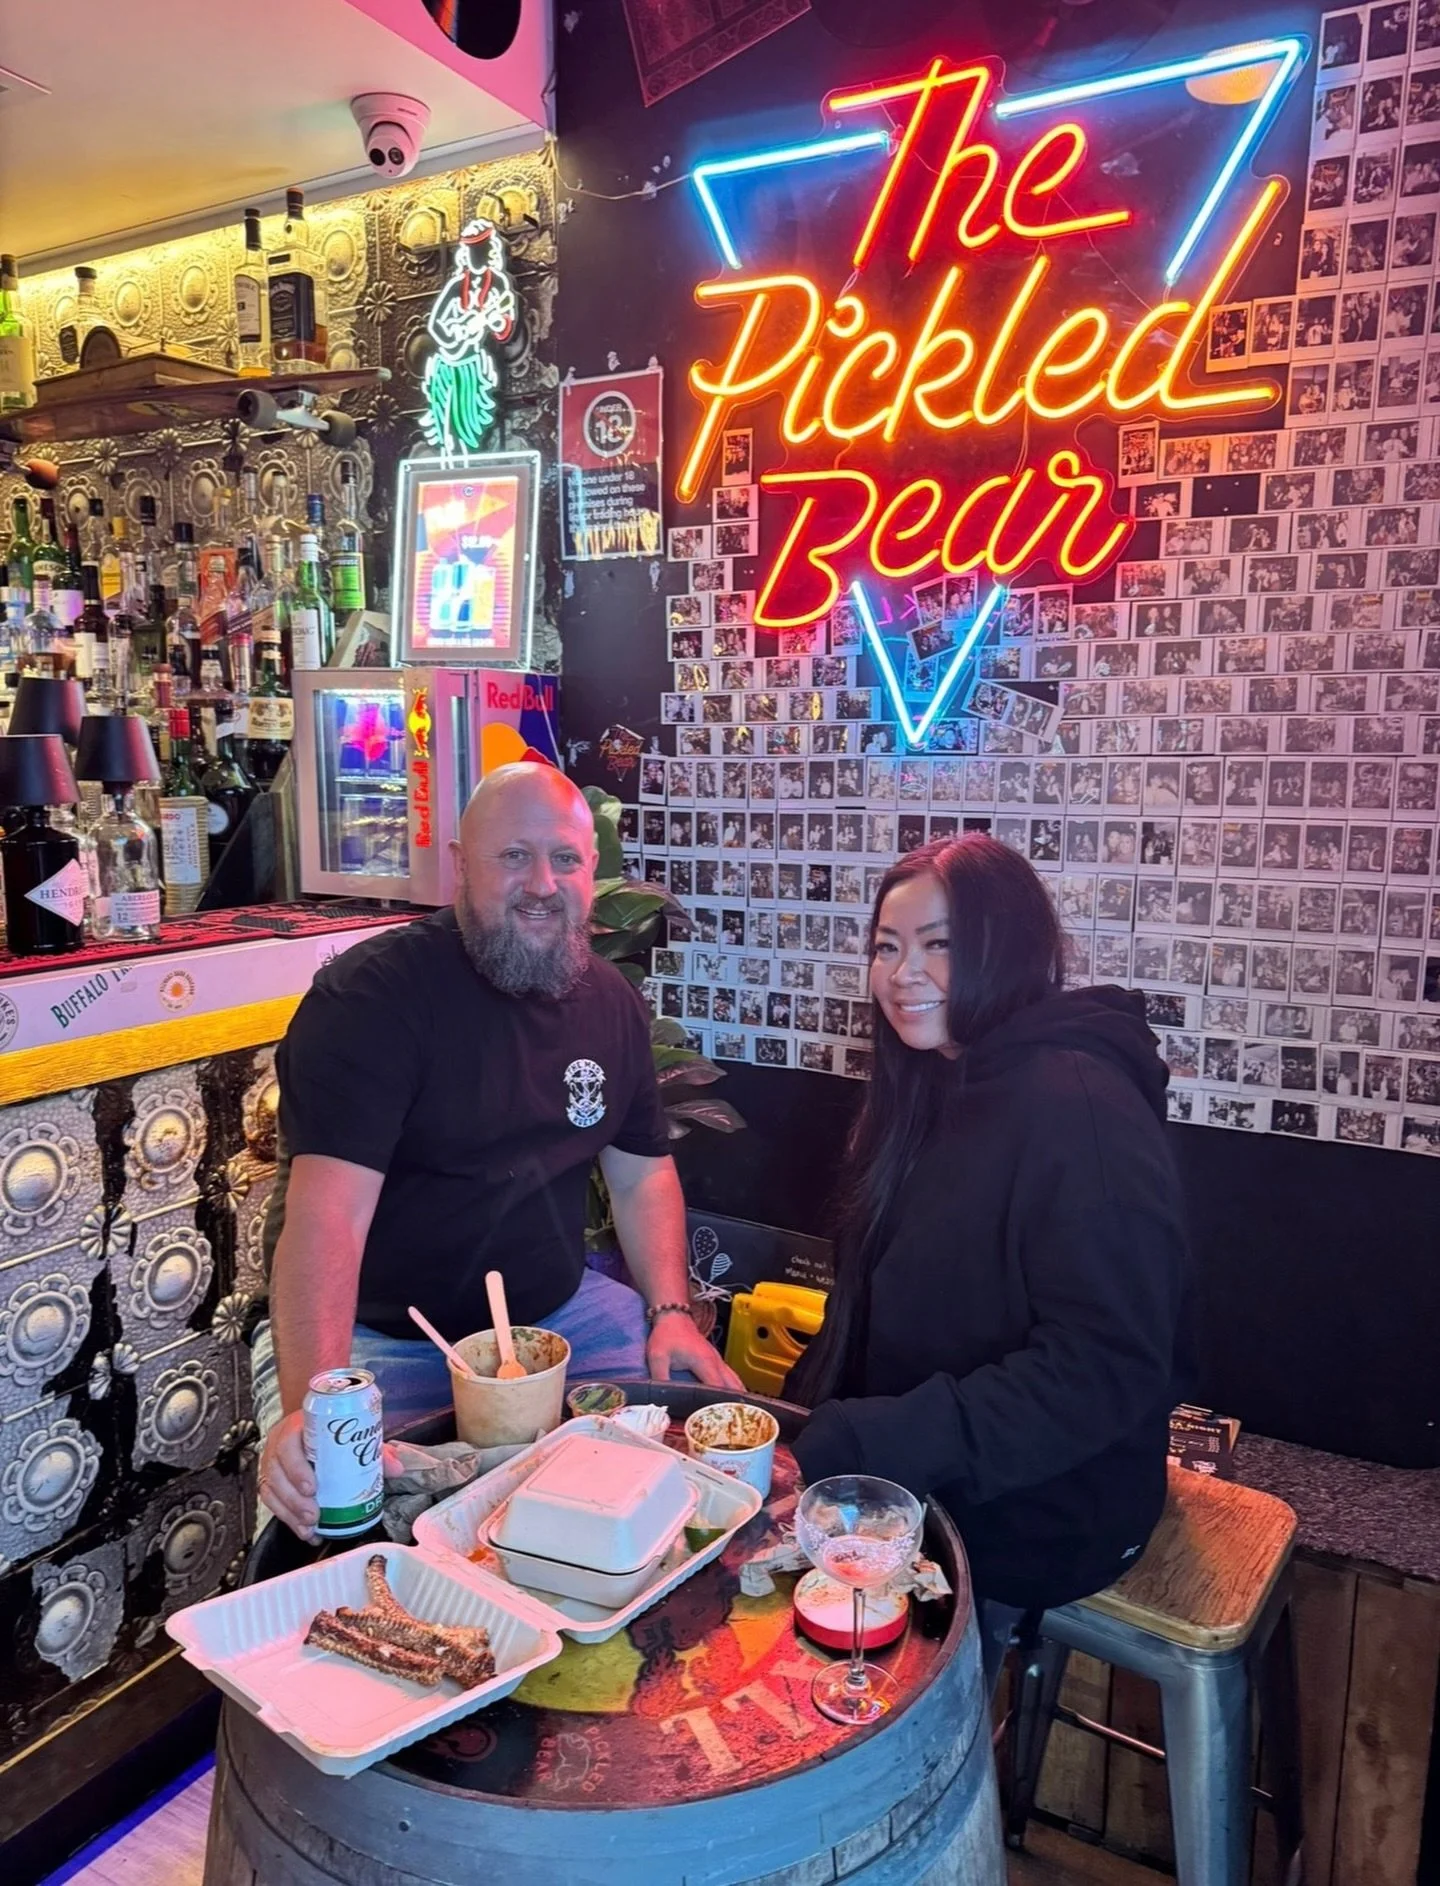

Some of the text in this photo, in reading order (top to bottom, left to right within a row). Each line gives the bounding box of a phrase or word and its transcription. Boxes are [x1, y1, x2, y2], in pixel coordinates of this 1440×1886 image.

[829, 58, 1131, 268] The
[677, 179, 1281, 501] Pickled
[598, 472, 623, 483] under
[606, 496, 634, 507] during
[621, 484, 646, 493] these
[753, 449, 1135, 629] Bear
[486, 681, 554, 712] Red Bull
[411, 760, 432, 848] Red Bull
[50, 973, 109, 1029] BUFFALO
[536, 1737, 557, 1783] BEAR
[583, 1726, 611, 1792] PICKLED
